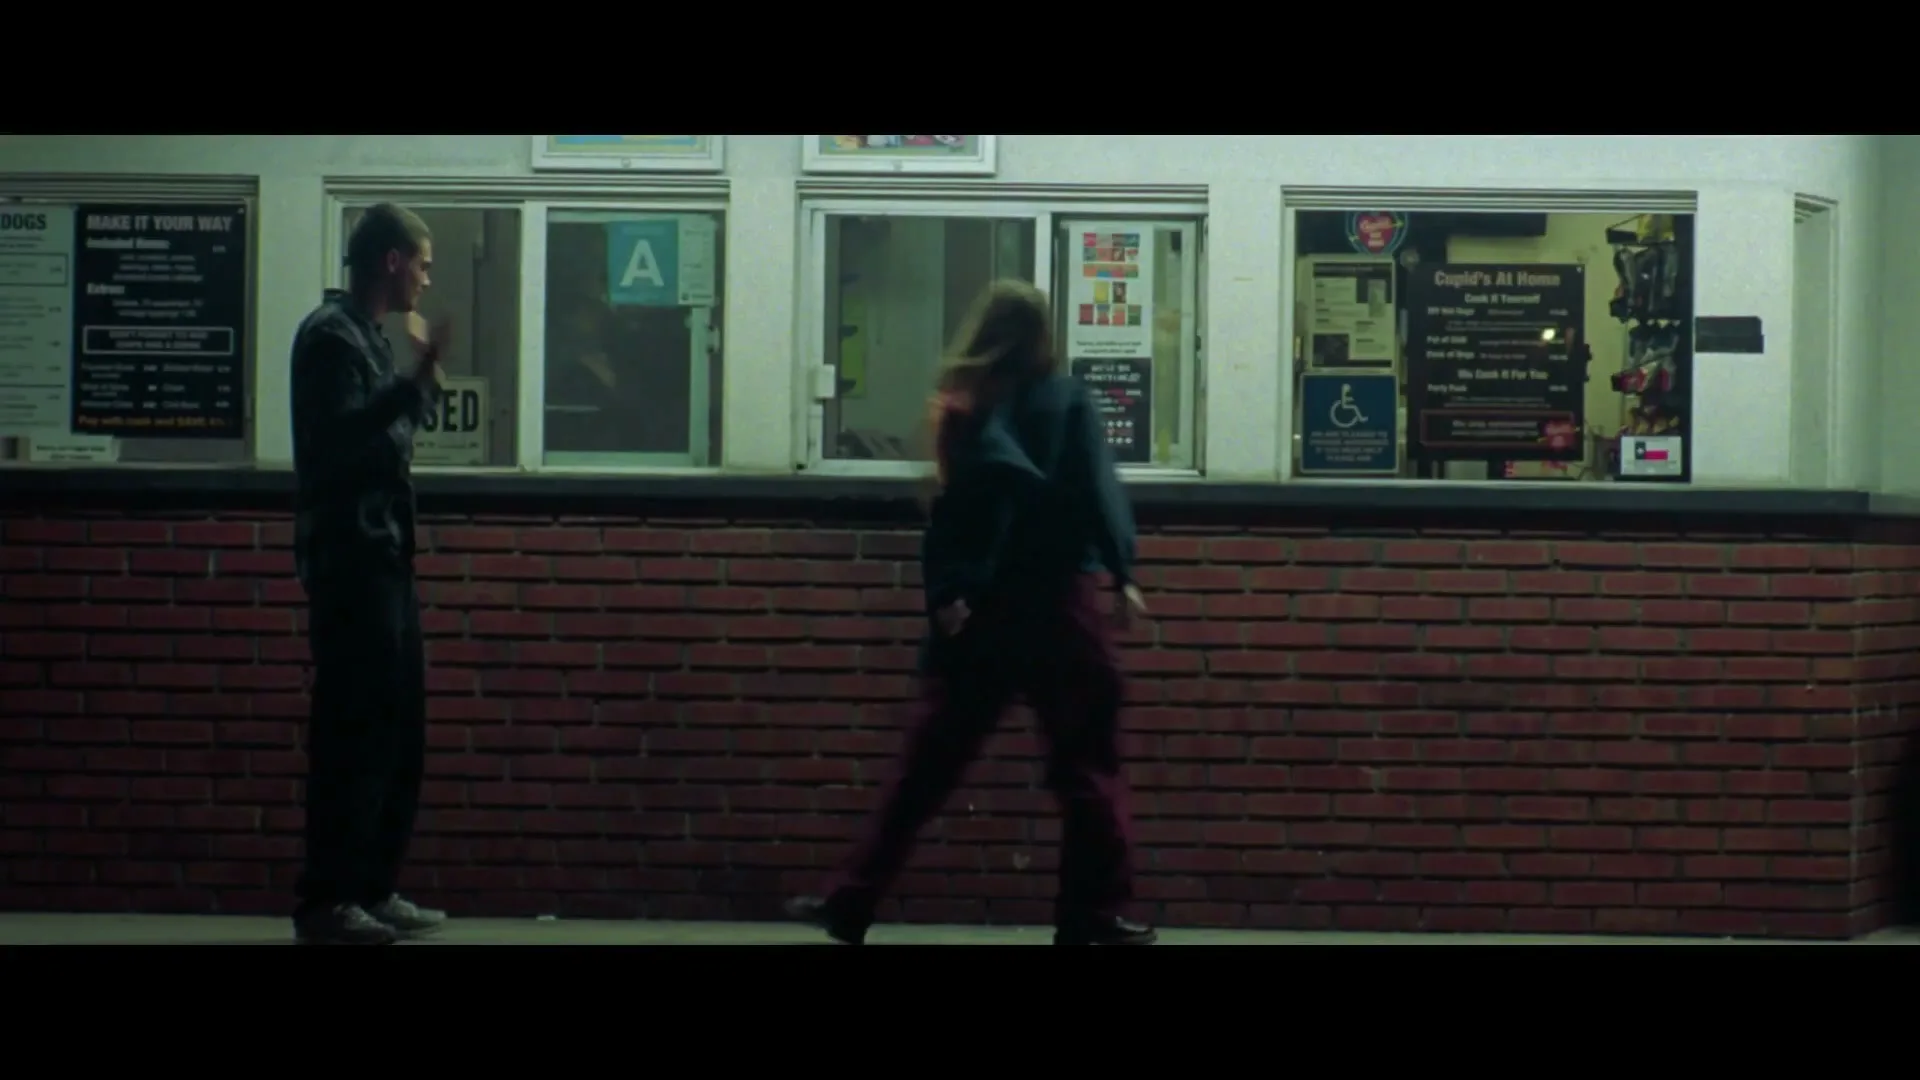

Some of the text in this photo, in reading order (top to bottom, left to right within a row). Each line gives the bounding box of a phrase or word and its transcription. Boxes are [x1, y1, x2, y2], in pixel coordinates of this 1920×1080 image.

[1, 213, 47, 231] DOGS
[86, 215, 233, 232] MAKE IT YOUR WAY
[619, 239, 665, 287] A
[1434, 270, 1561, 288] Cupid's At Home
[1464, 292, 1489, 304] Cook
[424, 389, 479, 433] SED
